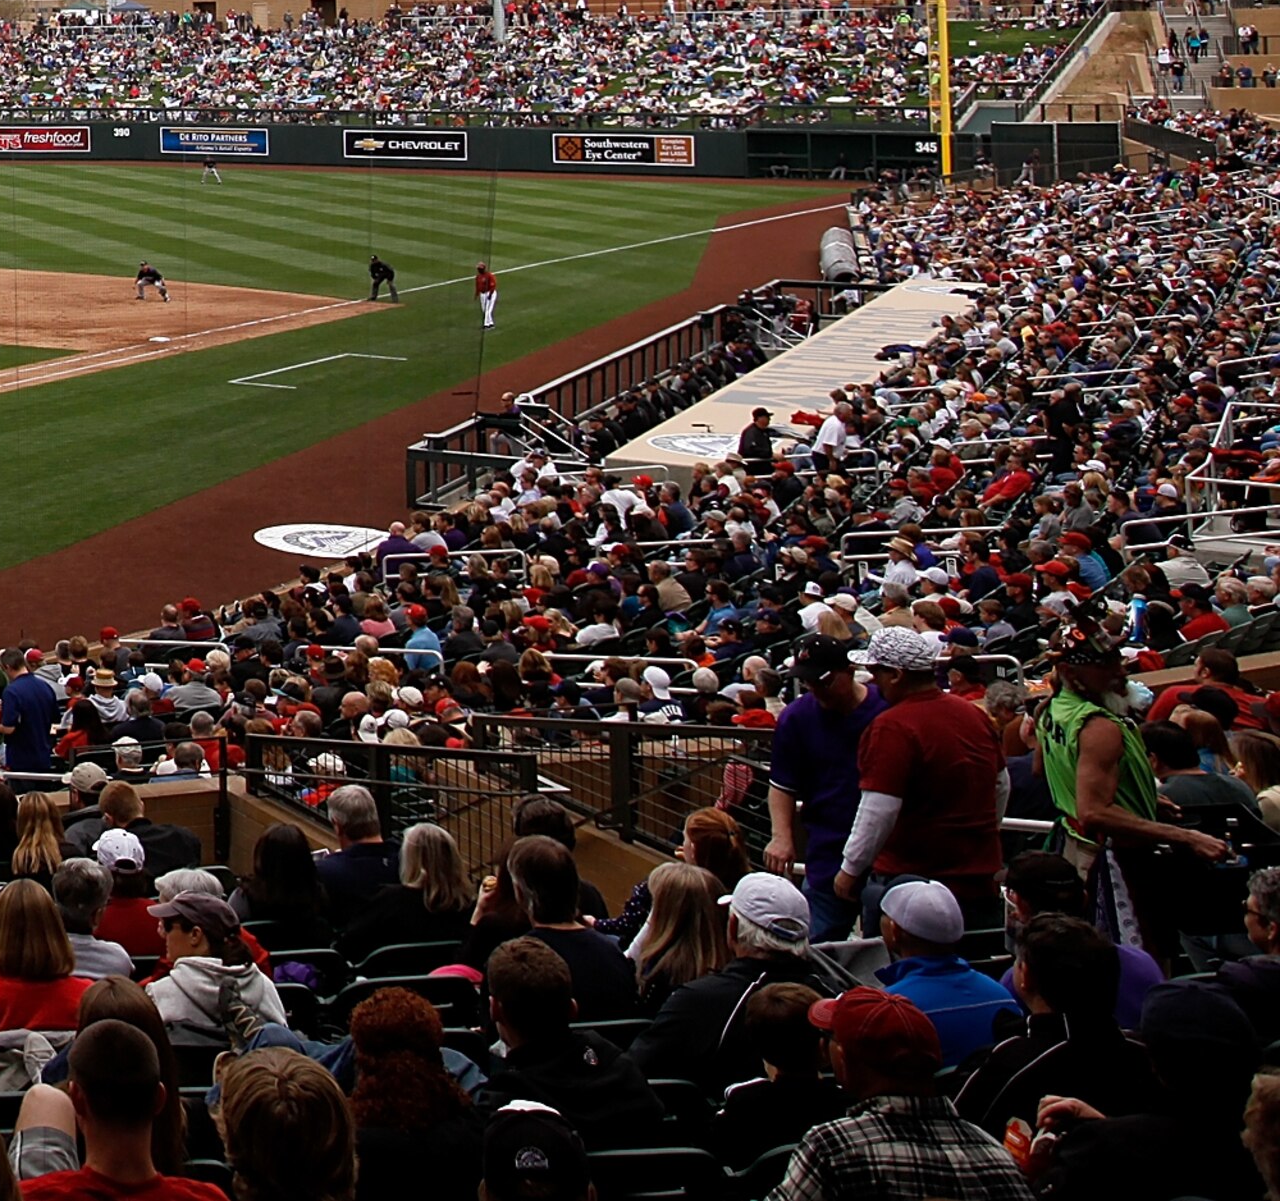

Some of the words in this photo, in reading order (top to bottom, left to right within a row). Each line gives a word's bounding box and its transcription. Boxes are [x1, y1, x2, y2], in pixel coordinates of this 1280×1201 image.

[23, 131, 82, 144] freshfood
[113, 128, 130, 137] 390
[191, 133, 209, 142] RITO
[210, 133, 248, 142] PARTNERS
[388, 140, 460, 151] CHEVROLET
[584, 138, 649, 149] Southwestern
[915, 141, 938, 153] 345
[585, 150, 602, 161] Eye
